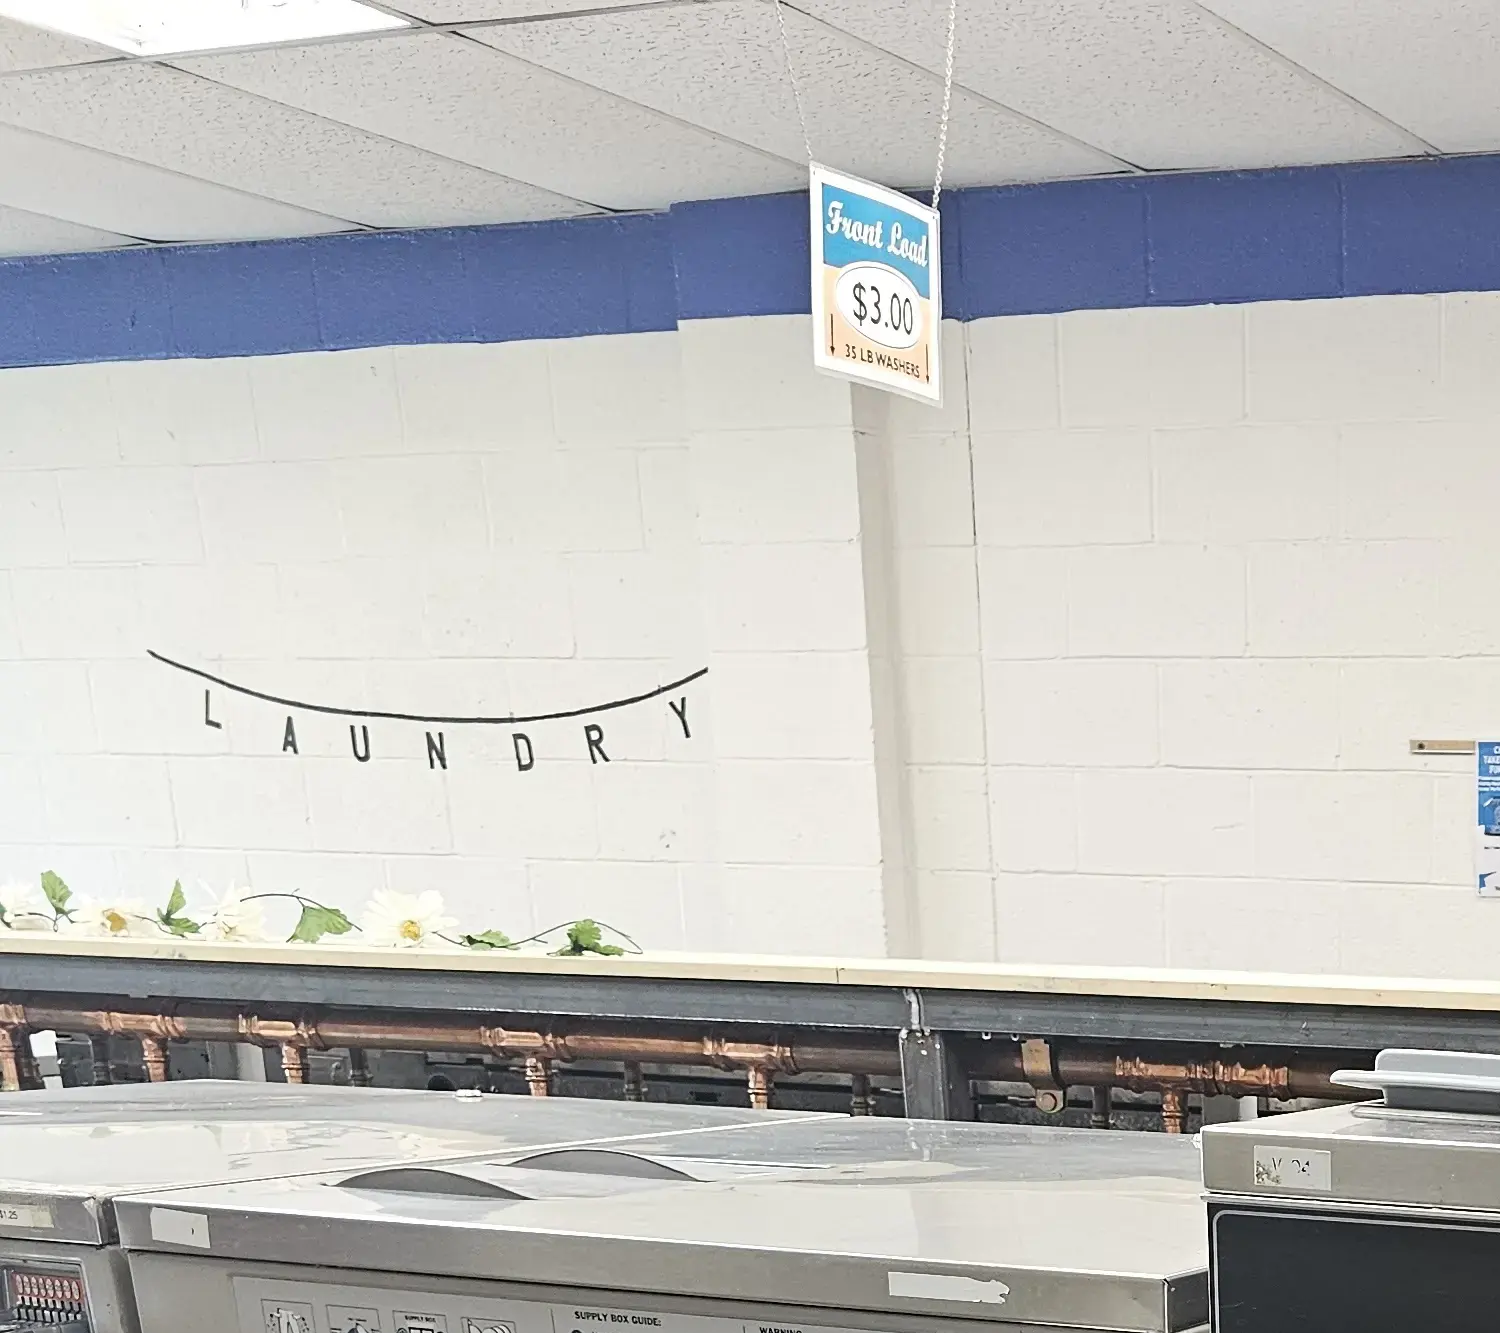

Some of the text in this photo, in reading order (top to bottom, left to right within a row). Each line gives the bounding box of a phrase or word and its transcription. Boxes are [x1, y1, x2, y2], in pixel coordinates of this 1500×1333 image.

[826, 200, 928, 268] Front Load
[852, 282, 914, 336] $3.00
[844, 344, 921, 380] 35 LB WASHERS
[204, 689, 692, 772] LAUNDRY
[574, 1311, 608, 1322] SUPPLY
[611, 1314, 629, 1324] BOX
